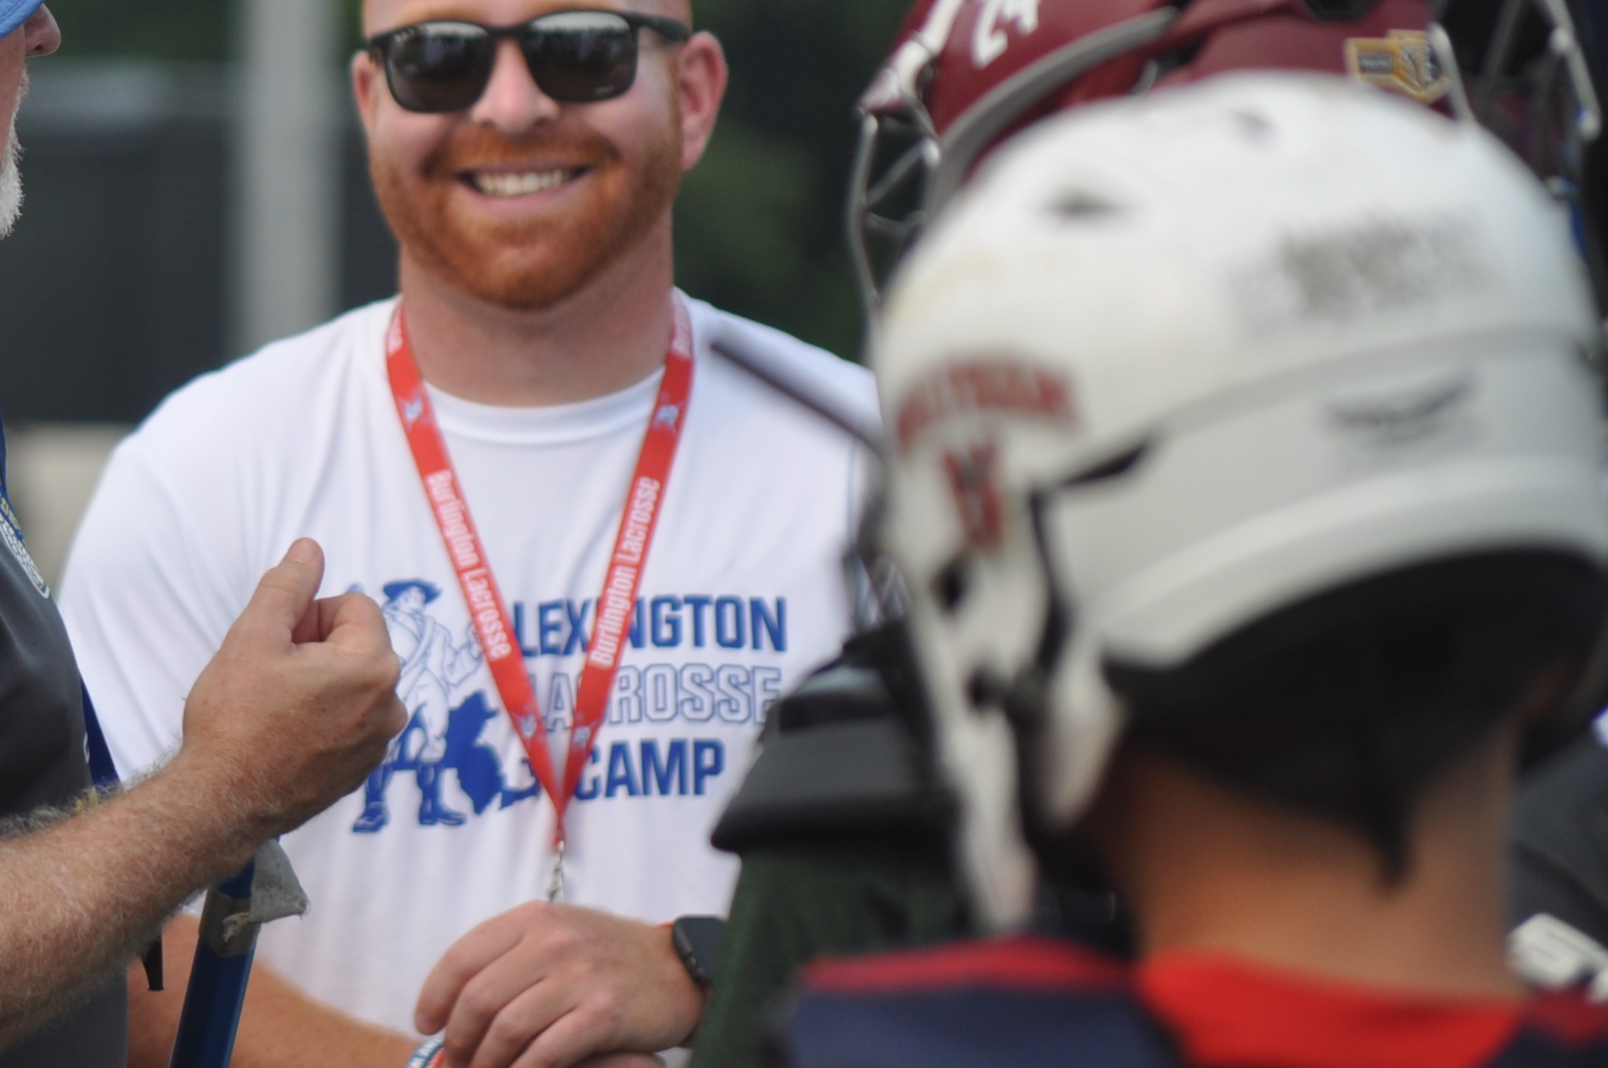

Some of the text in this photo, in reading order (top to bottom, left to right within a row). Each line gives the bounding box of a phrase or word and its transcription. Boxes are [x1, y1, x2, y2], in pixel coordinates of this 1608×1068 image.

[425, 469, 512, 661] Burlington Lacrosse
[512, 592, 787, 659] LEXNGTON
[587, 475, 661, 669] Burlington Lacrosse
[530, 662, 782, 733] AROSSE
